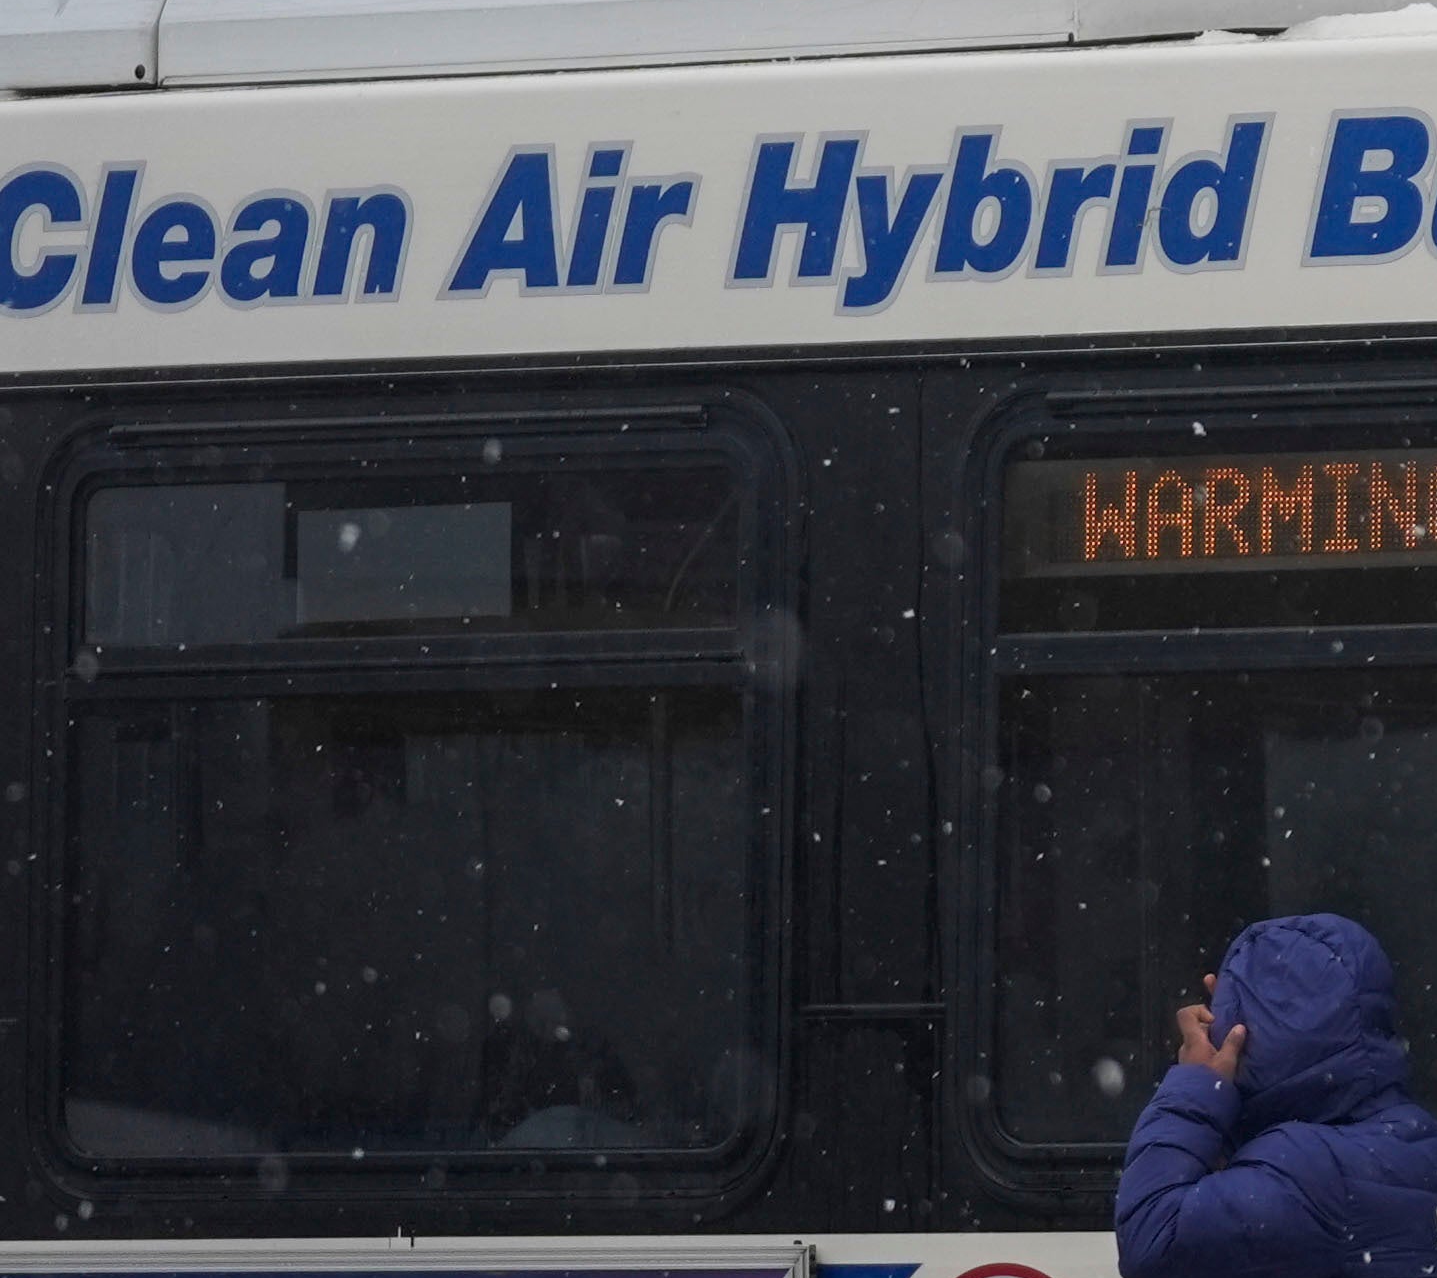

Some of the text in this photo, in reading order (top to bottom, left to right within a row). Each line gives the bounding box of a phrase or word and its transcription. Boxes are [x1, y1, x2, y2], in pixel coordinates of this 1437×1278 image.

[0, 163, 411, 315] Clean
[441, 144, 698, 296] Air
[728, 115, 1272, 313] Hybrid
